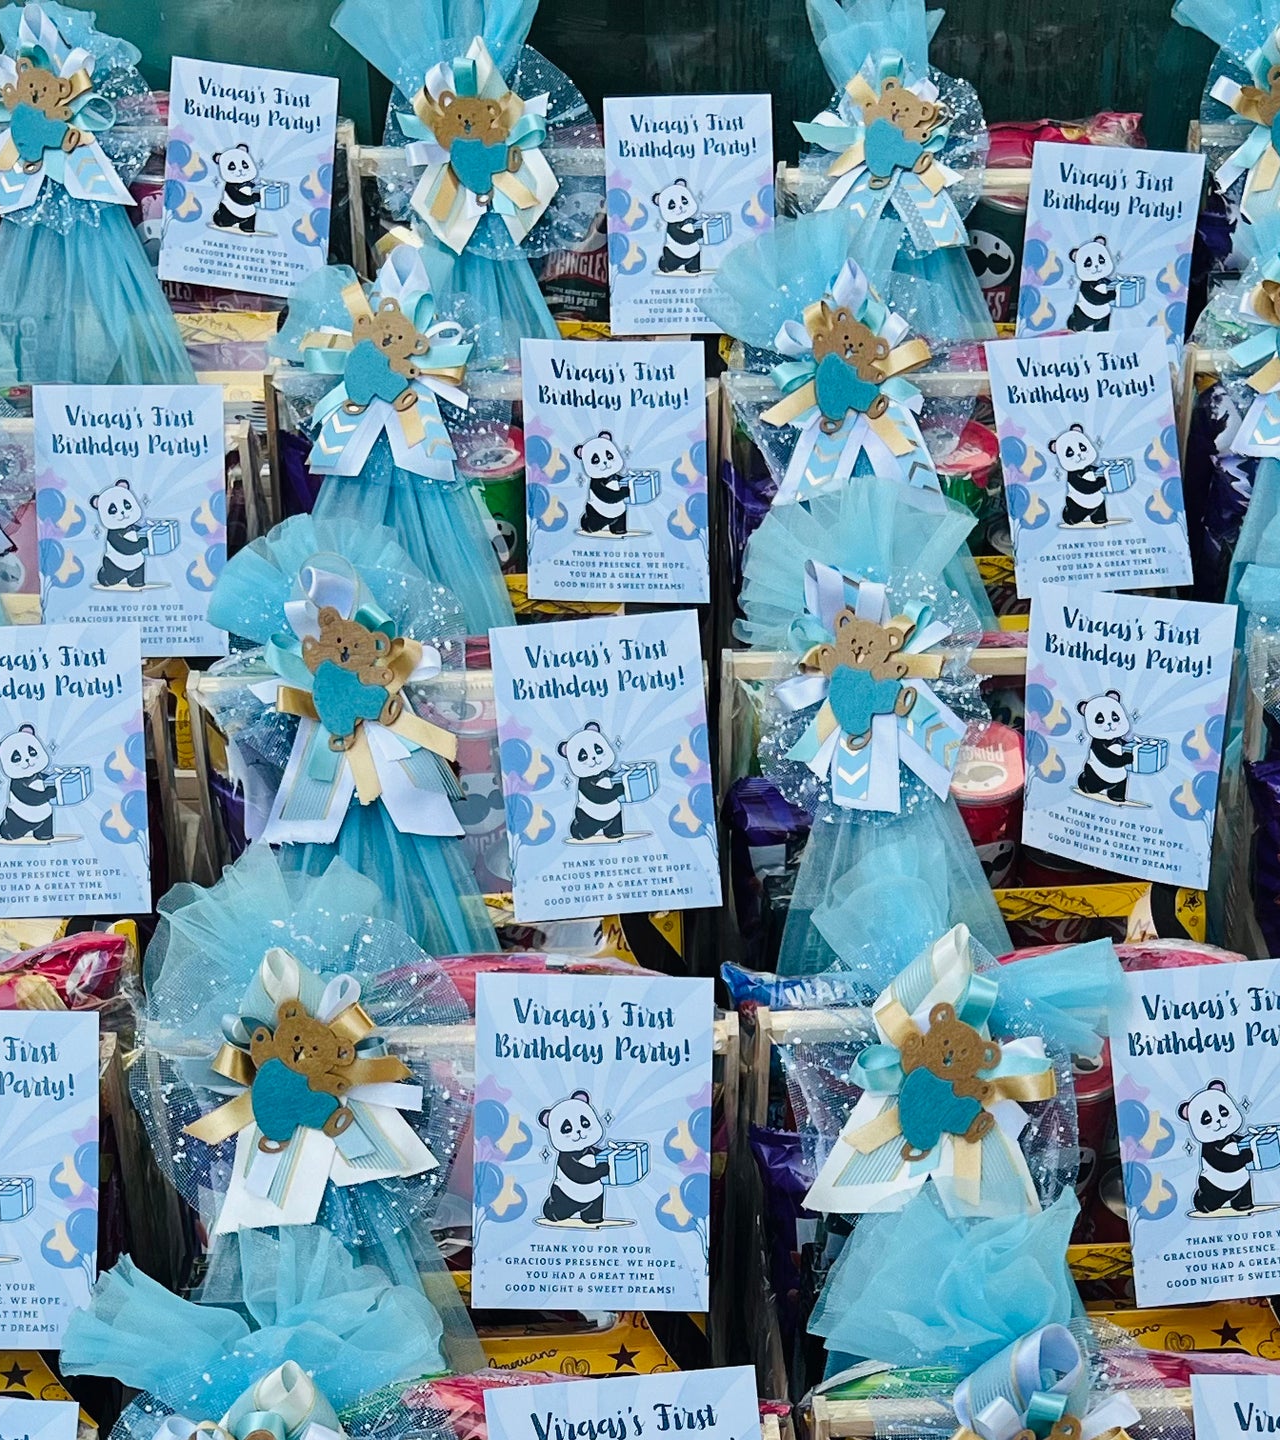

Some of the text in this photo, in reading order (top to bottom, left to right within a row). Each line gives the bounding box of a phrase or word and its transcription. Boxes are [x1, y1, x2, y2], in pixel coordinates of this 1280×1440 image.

[524, 638, 670, 668] Viraaj's First
[513, 666, 684, 700] Birthday Party!
[512, 997, 677, 1030] Viraaj's First
[1141, 989, 1240, 1020] Viraaj's
[497, 1033, 690, 1066] Birthday Party!
[1128, 1027, 1234, 1057] Birthday
[551, 1271, 575, 1279] HAD
[653, 1403, 719, 1431] First
